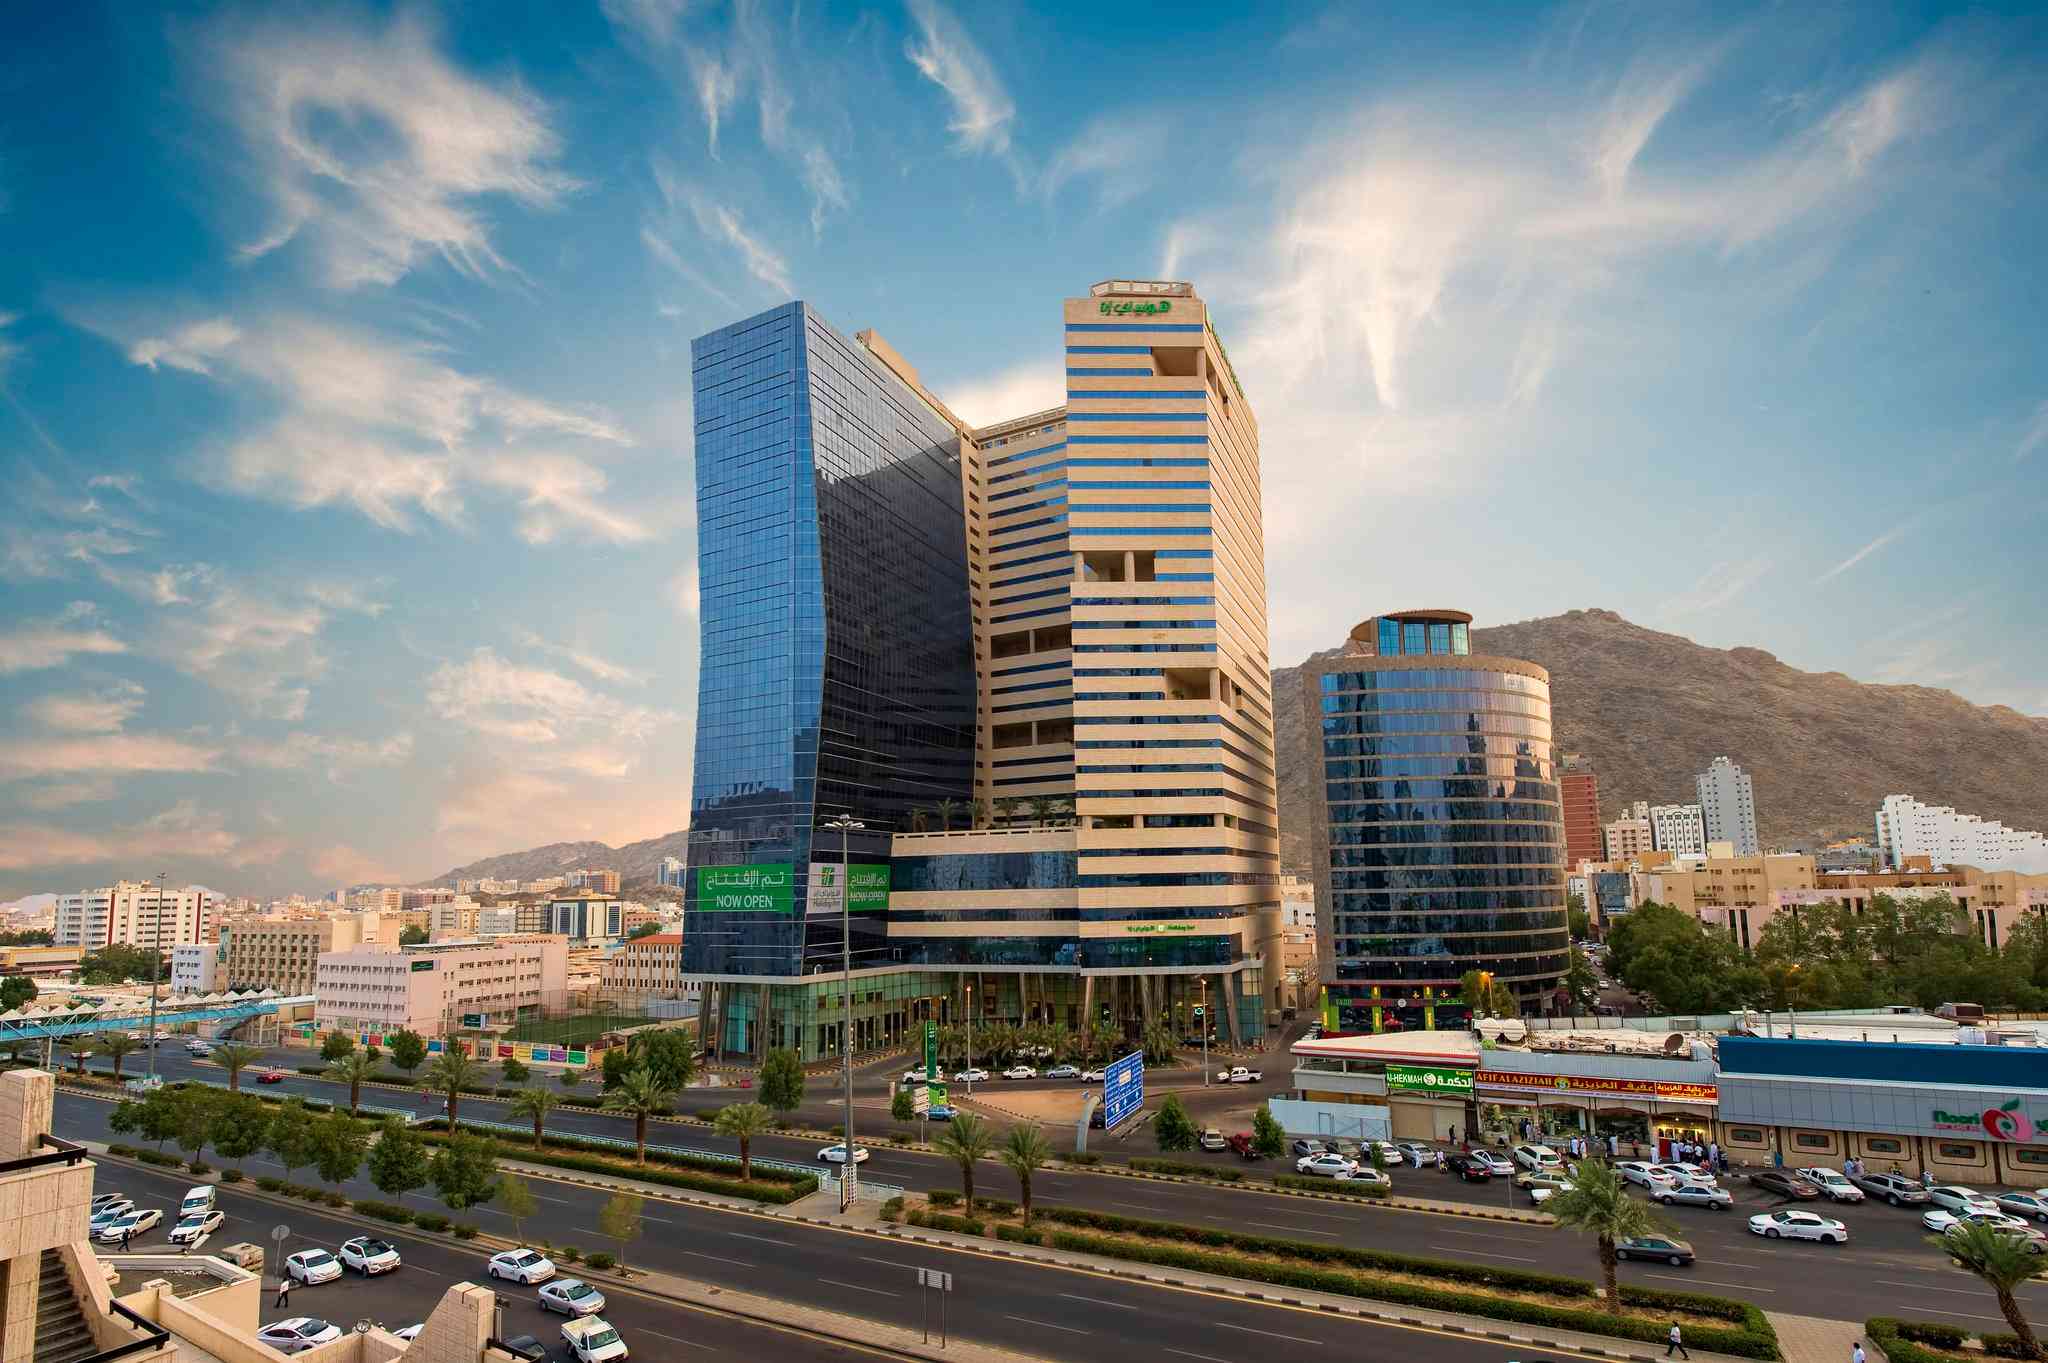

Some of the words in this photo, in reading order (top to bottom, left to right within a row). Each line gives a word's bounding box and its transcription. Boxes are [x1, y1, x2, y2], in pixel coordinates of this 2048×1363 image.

[706, 868, 759, 890] الإفتتاح
[761, 871, 784, 890] تم
[716, 895, 742, 907] NOW
[743, 895, 773, 907] OPEN
[1437, 1075, 1473, 1087] الحكمة
[1572, 1079, 1617, 1090] العزيزية
[1621, 1081, 1655, 1092] عفيف
